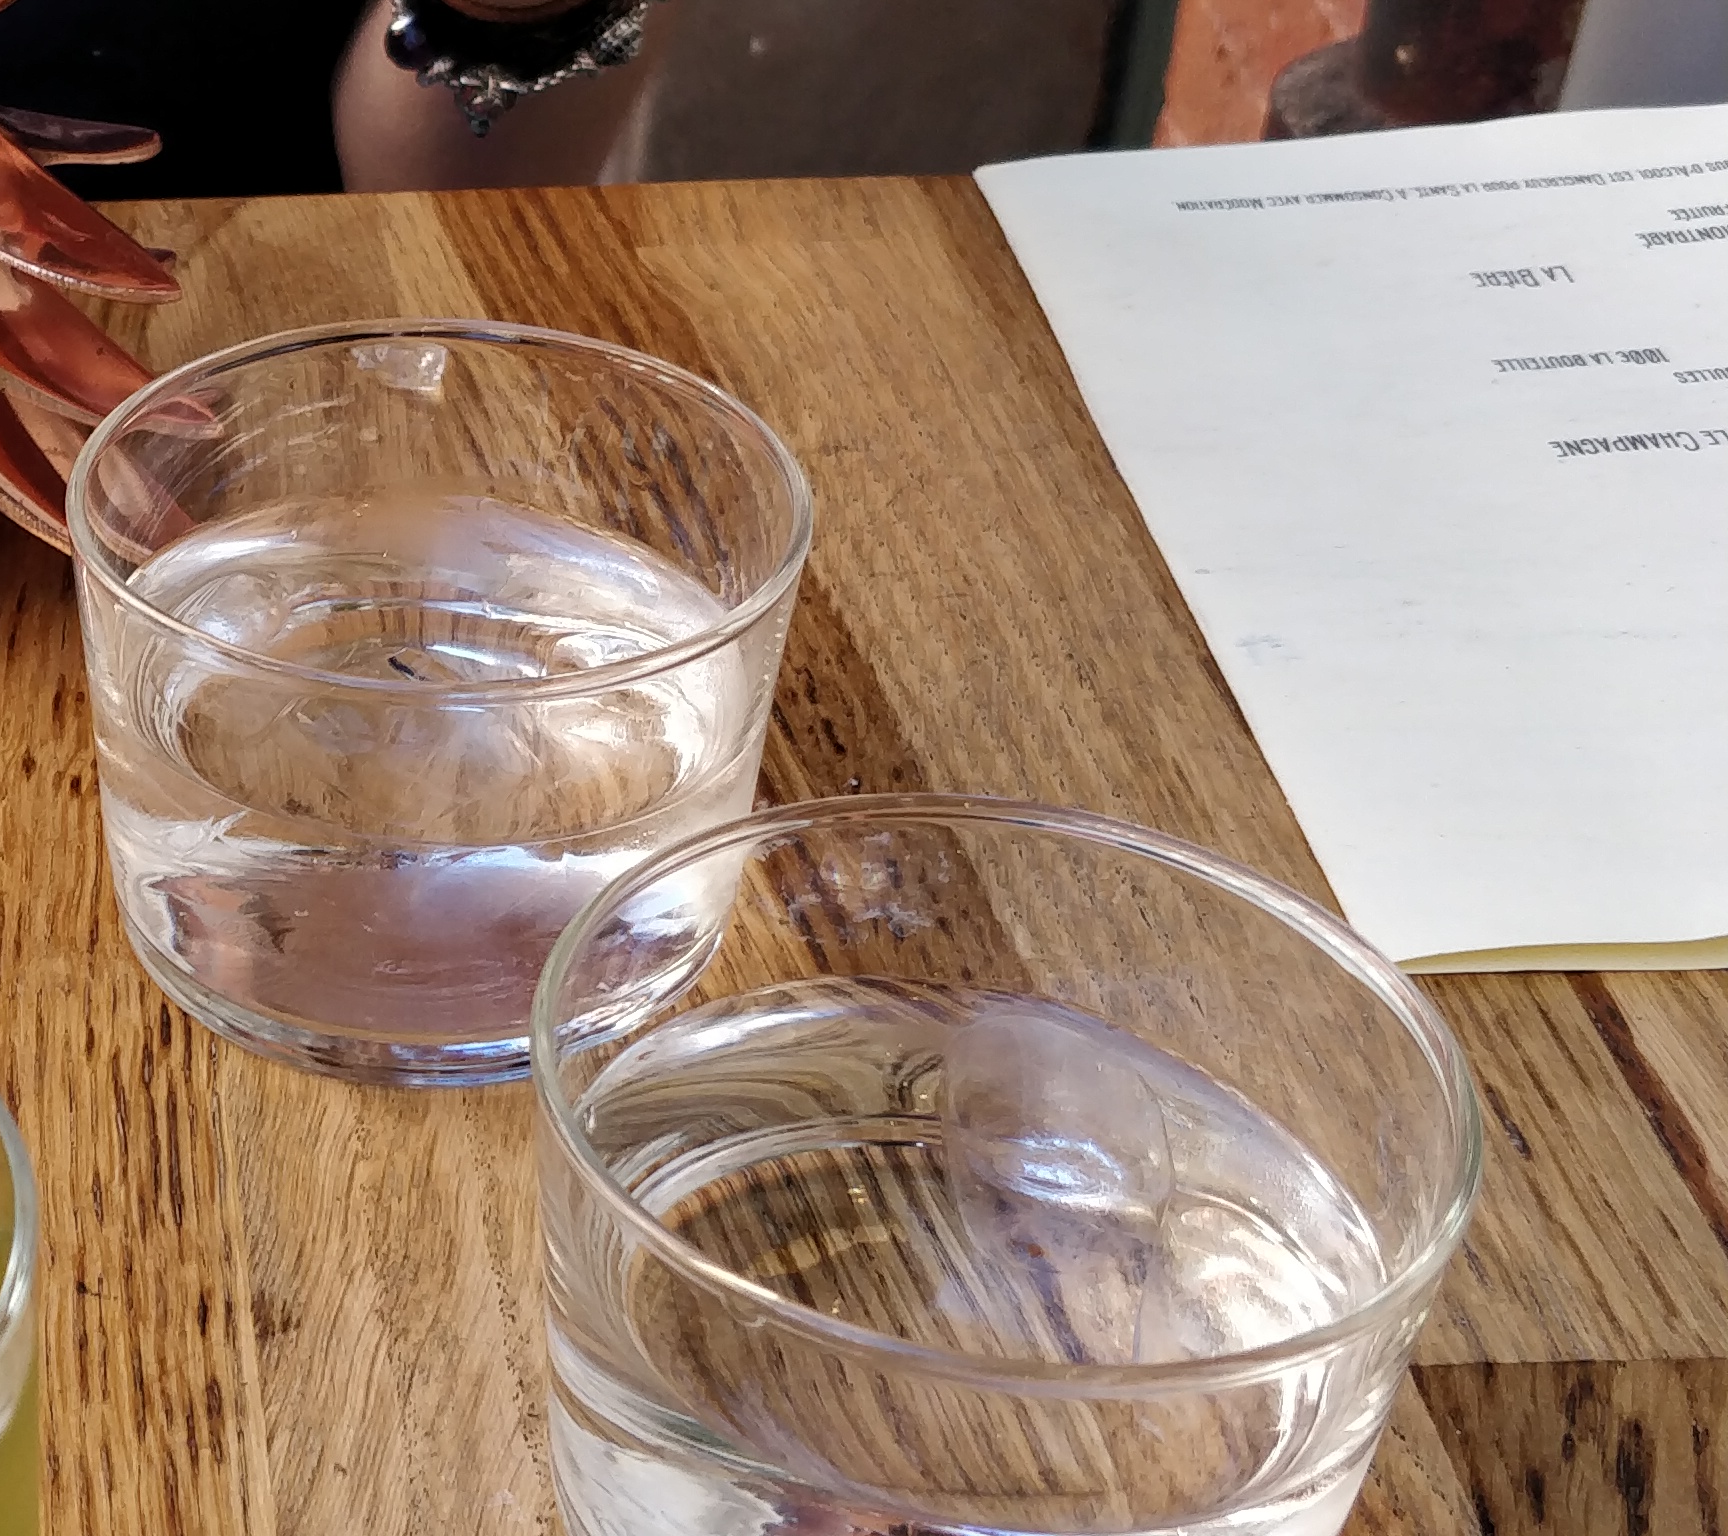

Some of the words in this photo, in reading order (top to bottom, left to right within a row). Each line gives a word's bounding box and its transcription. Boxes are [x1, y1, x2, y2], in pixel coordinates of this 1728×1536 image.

[1491, 355, 1589, 372] BOUTEILLE
[1589, 352, 1612, 364] LA
[1548, 431, 1700, 458] CHAMPAGNE
